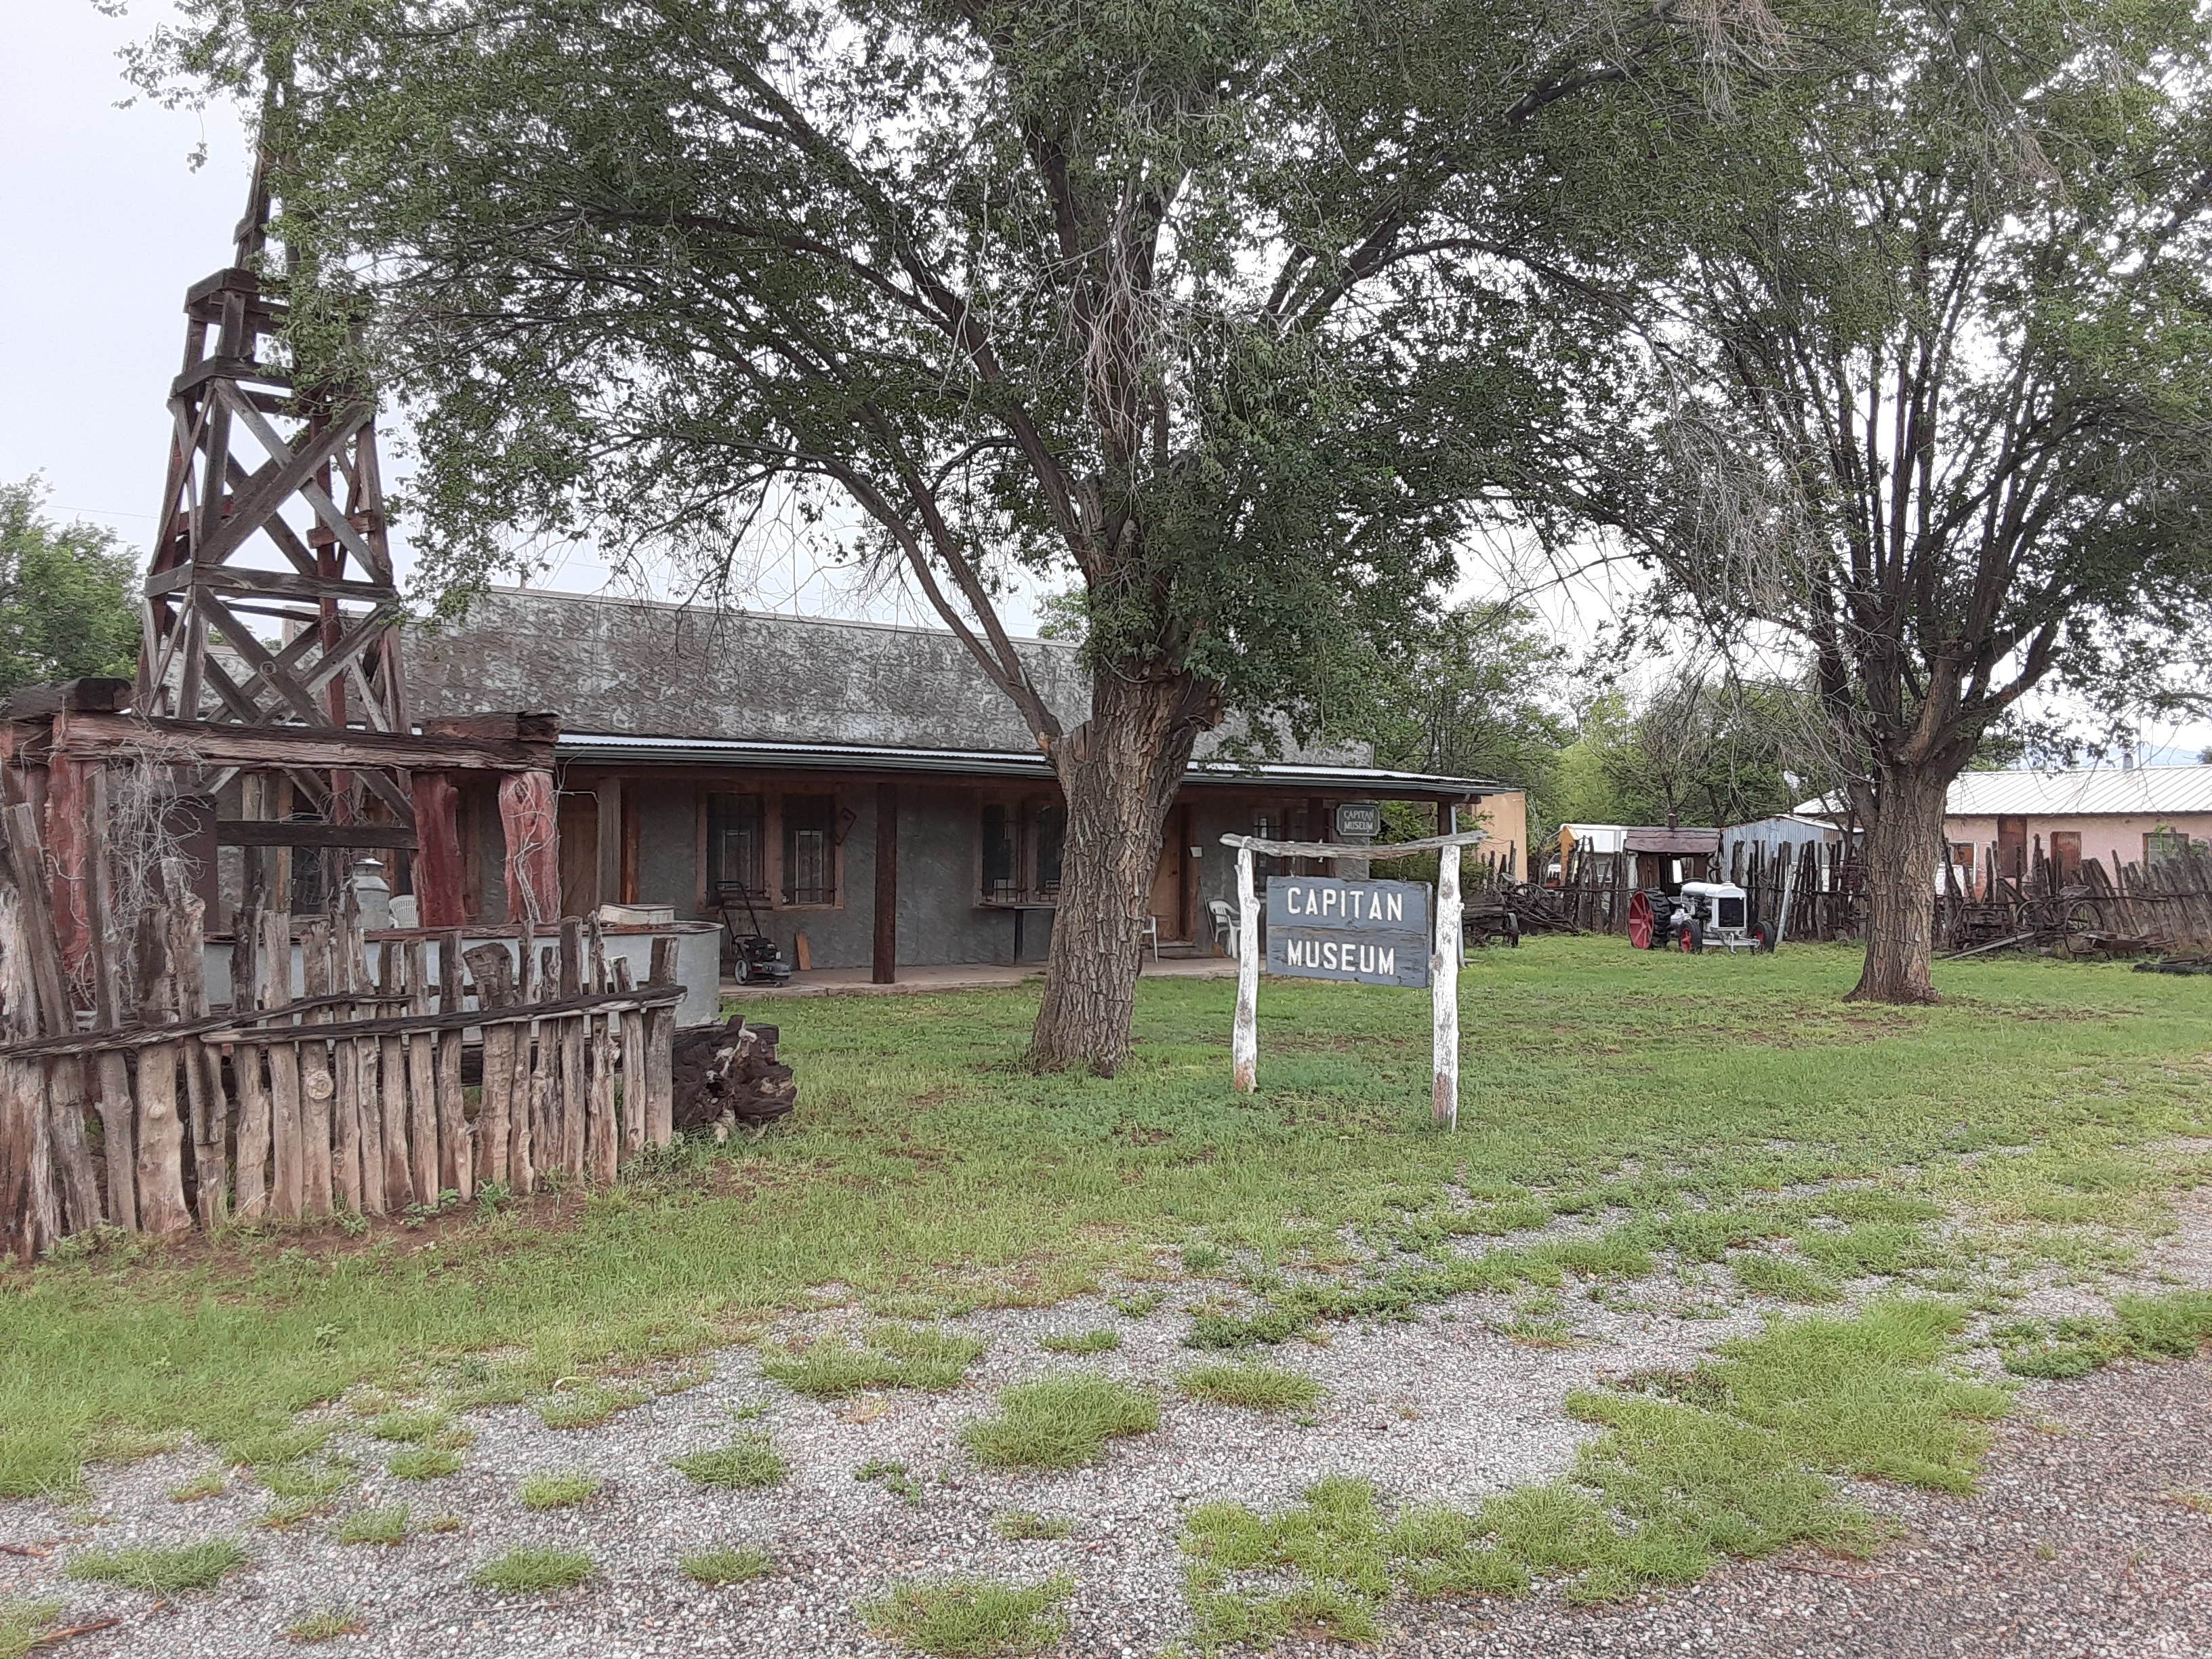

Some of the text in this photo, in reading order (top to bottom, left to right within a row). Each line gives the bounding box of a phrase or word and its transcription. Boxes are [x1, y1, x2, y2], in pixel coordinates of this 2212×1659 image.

[1344, 808, 1374, 821] CAPITAN
[1344, 821, 1373, 832] MUSEUM
[1287, 887, 1403, 922] CAPITAN
[1288, 939, 1394, 975] MUSEUM
